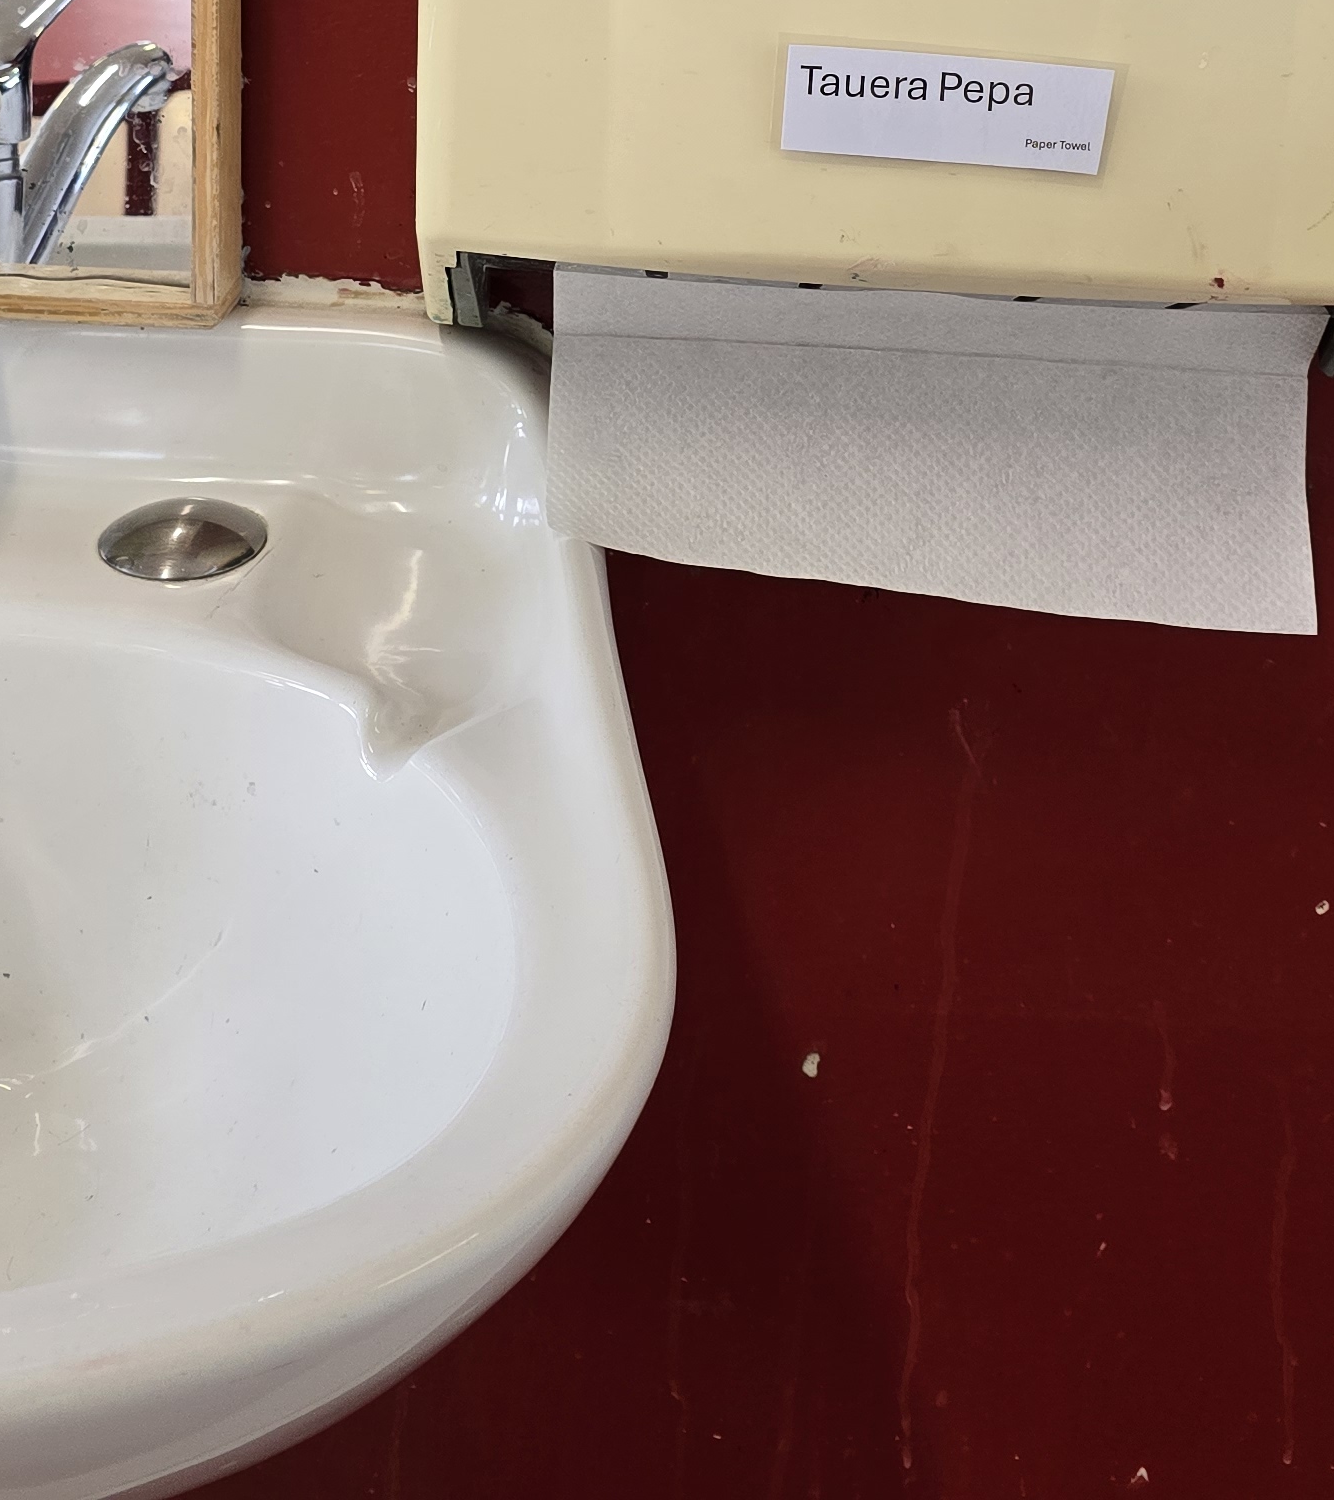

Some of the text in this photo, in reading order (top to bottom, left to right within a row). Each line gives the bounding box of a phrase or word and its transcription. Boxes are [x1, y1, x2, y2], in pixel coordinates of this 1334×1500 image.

[800, 65, 1034, 111] Tauera Pepa
[1025, 138, 1091, 152] Paper Towel
